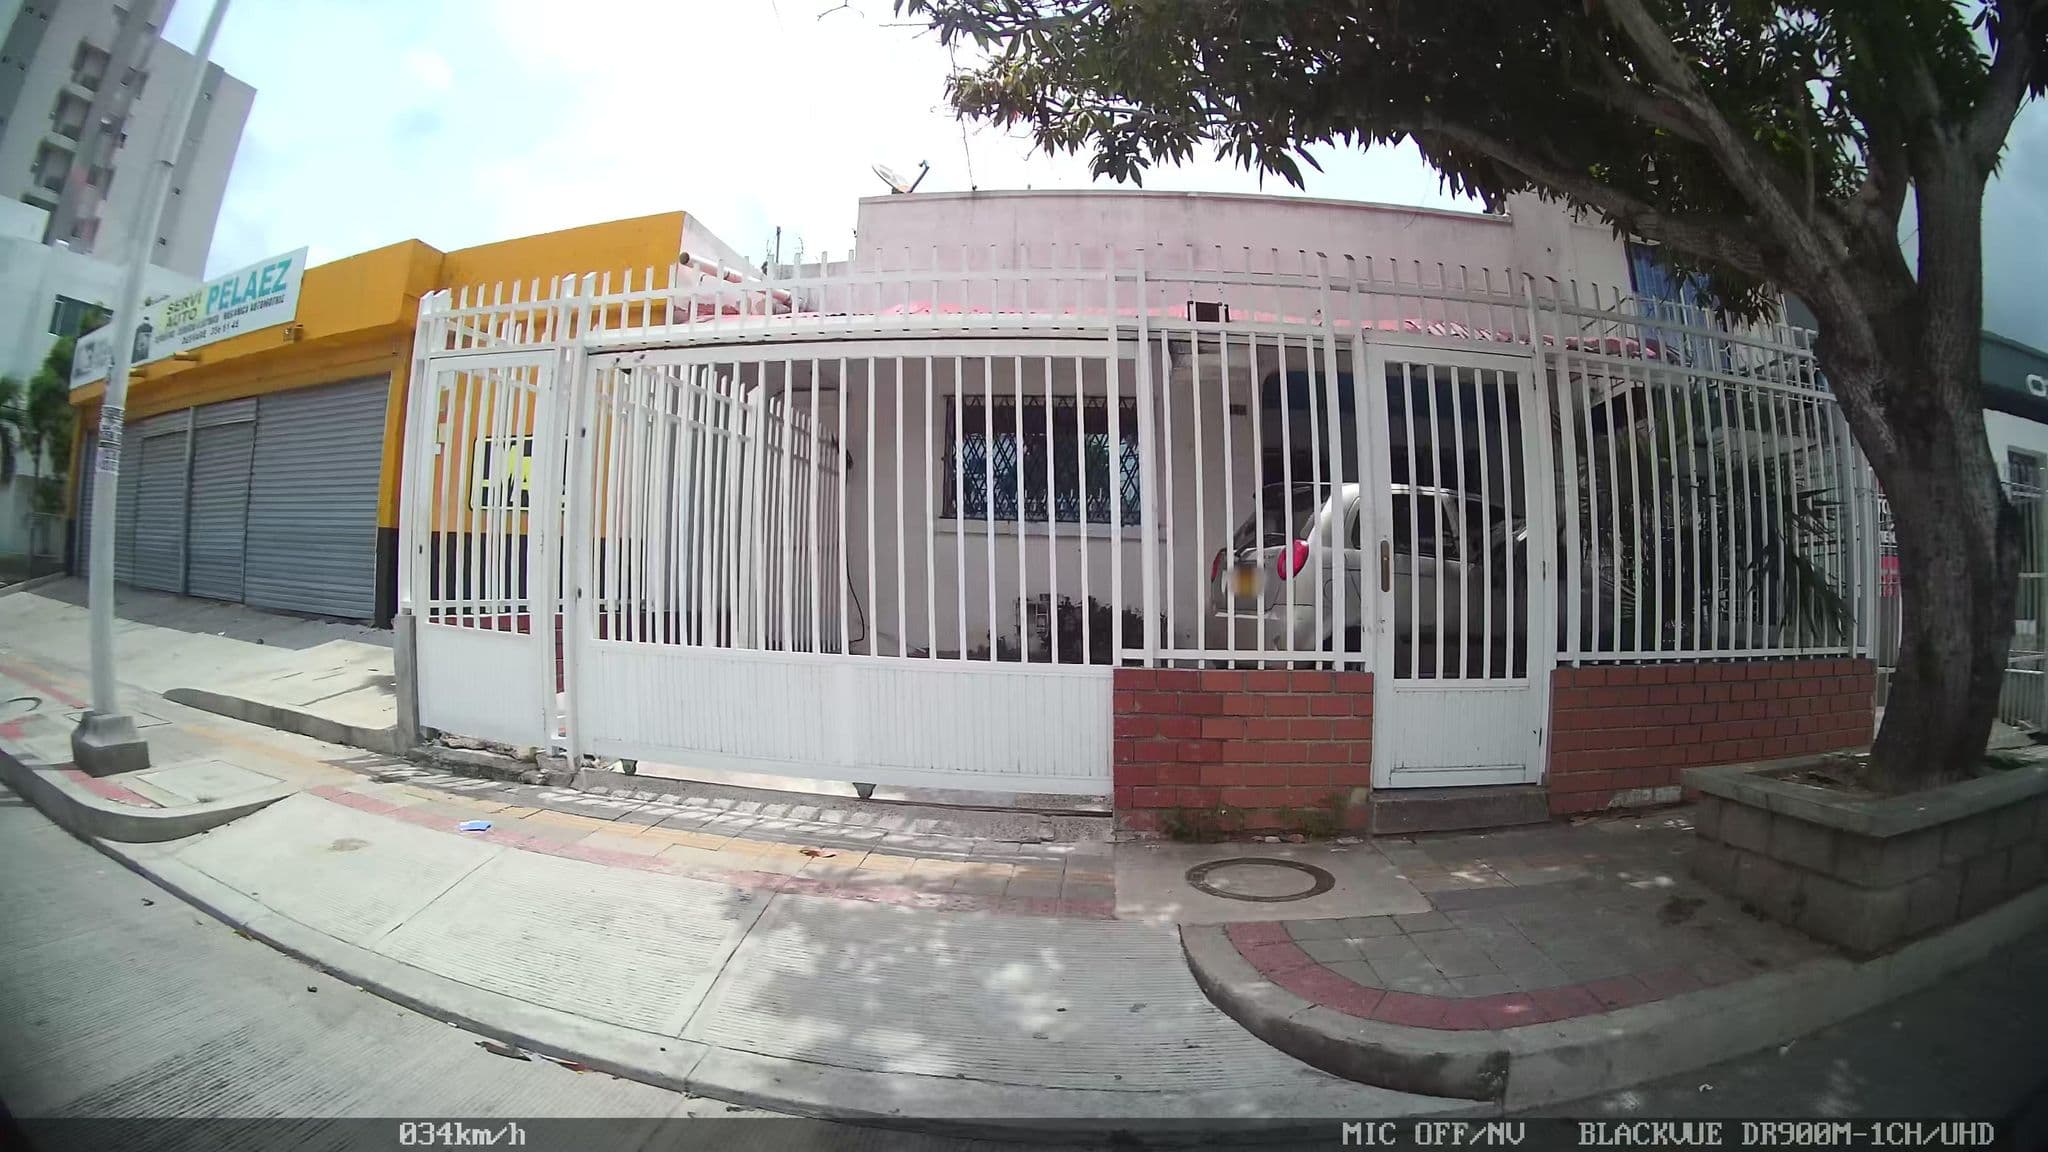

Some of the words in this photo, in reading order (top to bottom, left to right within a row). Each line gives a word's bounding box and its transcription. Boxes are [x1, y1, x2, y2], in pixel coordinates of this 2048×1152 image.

[206, 258, 292, 315] PELAEZ
[165, 291, 202, 316] SERVI
[165, 307, 198, 328] AUTO
